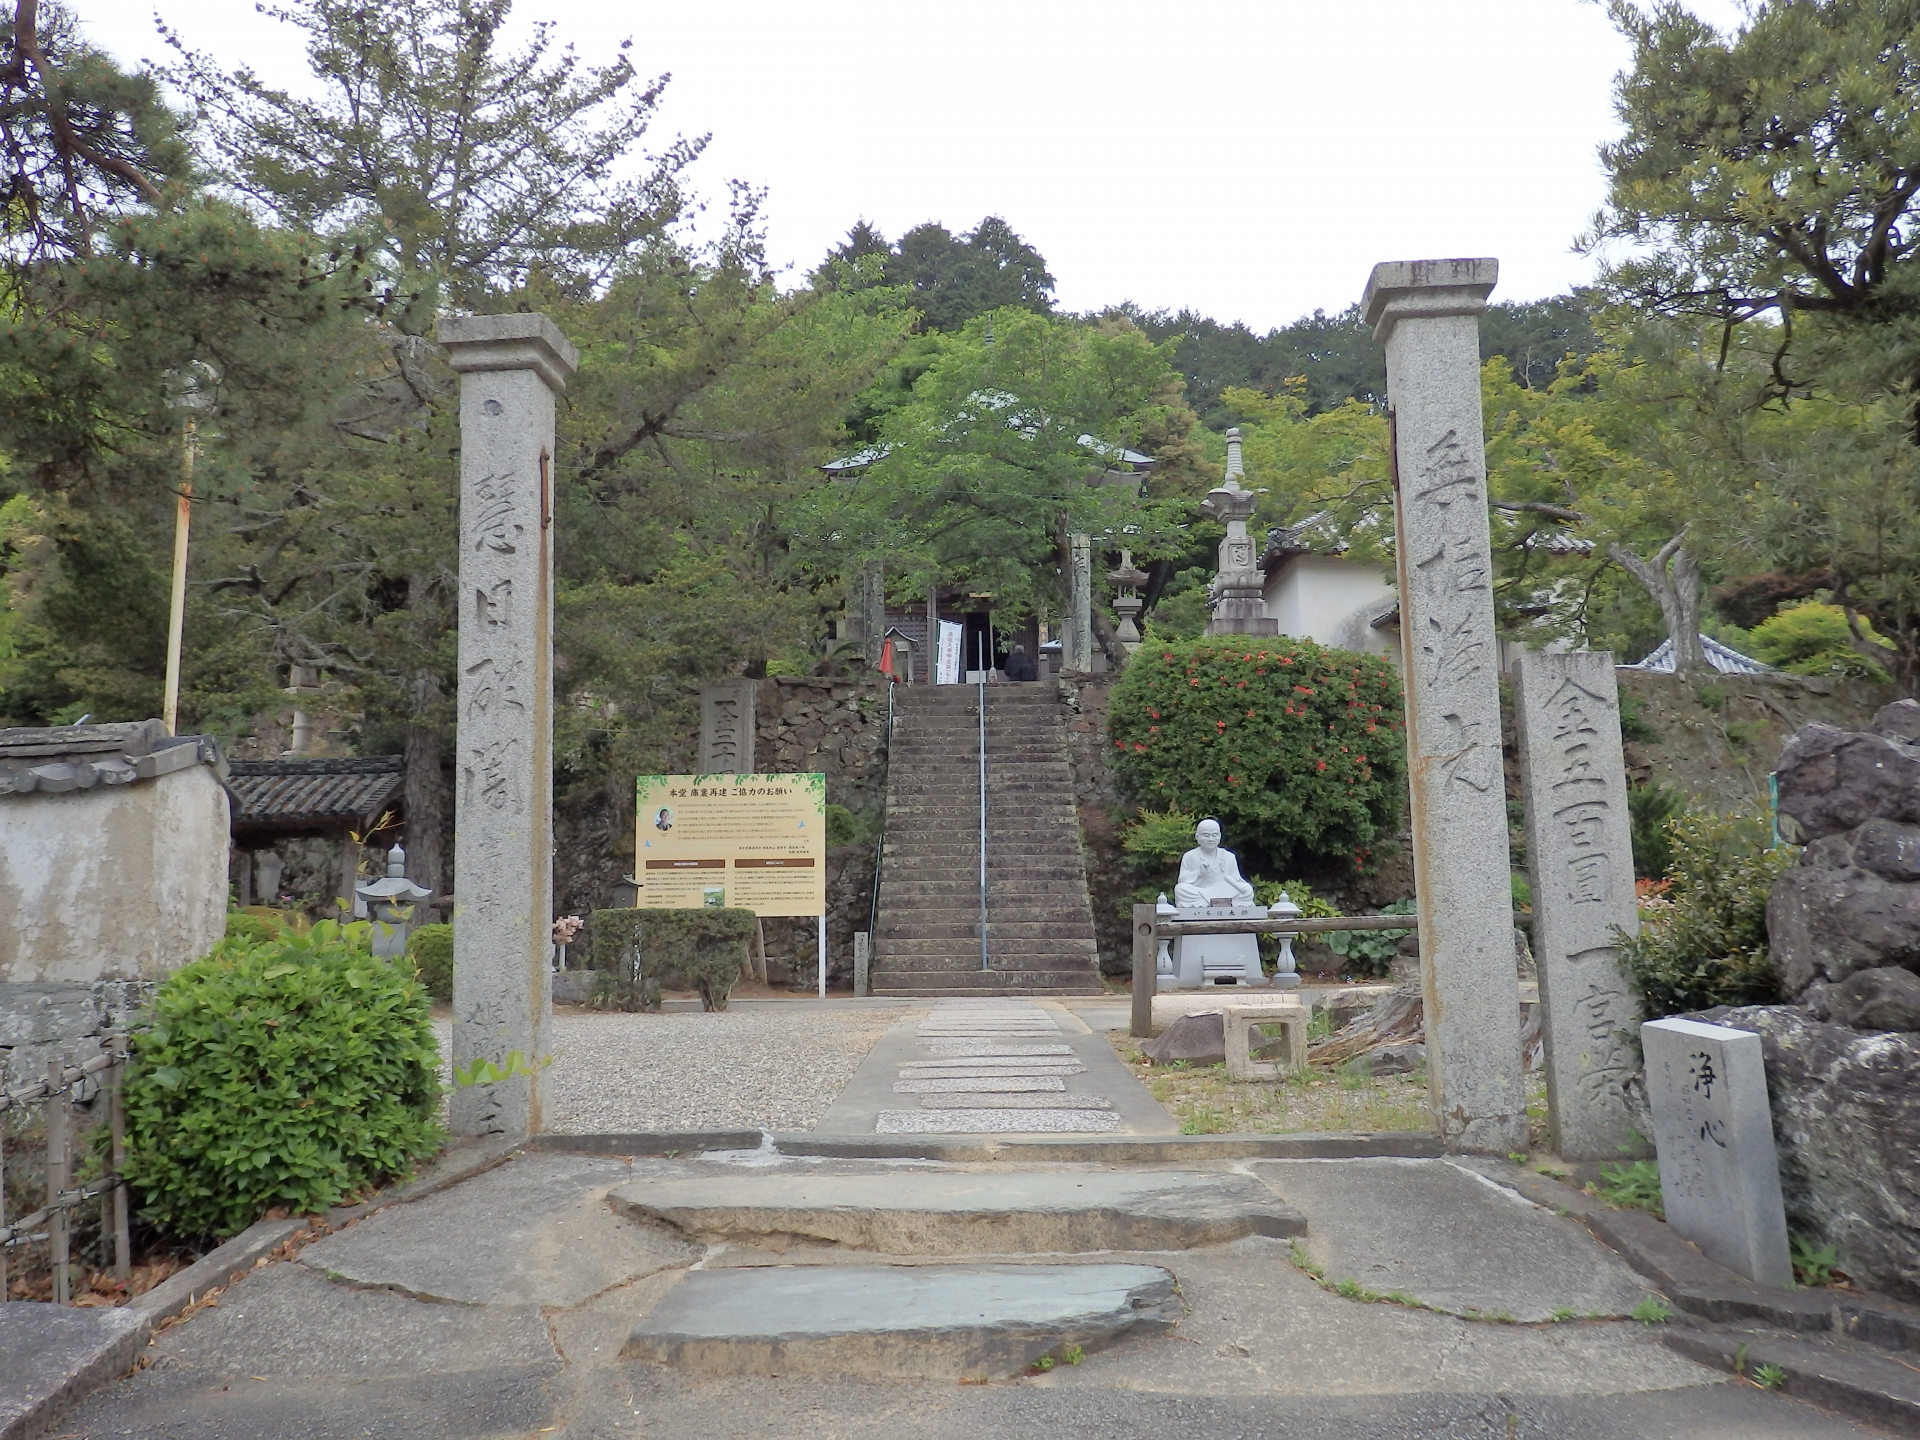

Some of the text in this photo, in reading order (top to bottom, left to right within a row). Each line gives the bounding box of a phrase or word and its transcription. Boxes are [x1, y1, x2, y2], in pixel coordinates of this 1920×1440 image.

[669, 787, 793, 798] 本堂 庫裏再建 ご協力のお願い
[1689, 1051, 1727, 1149] 浄心
